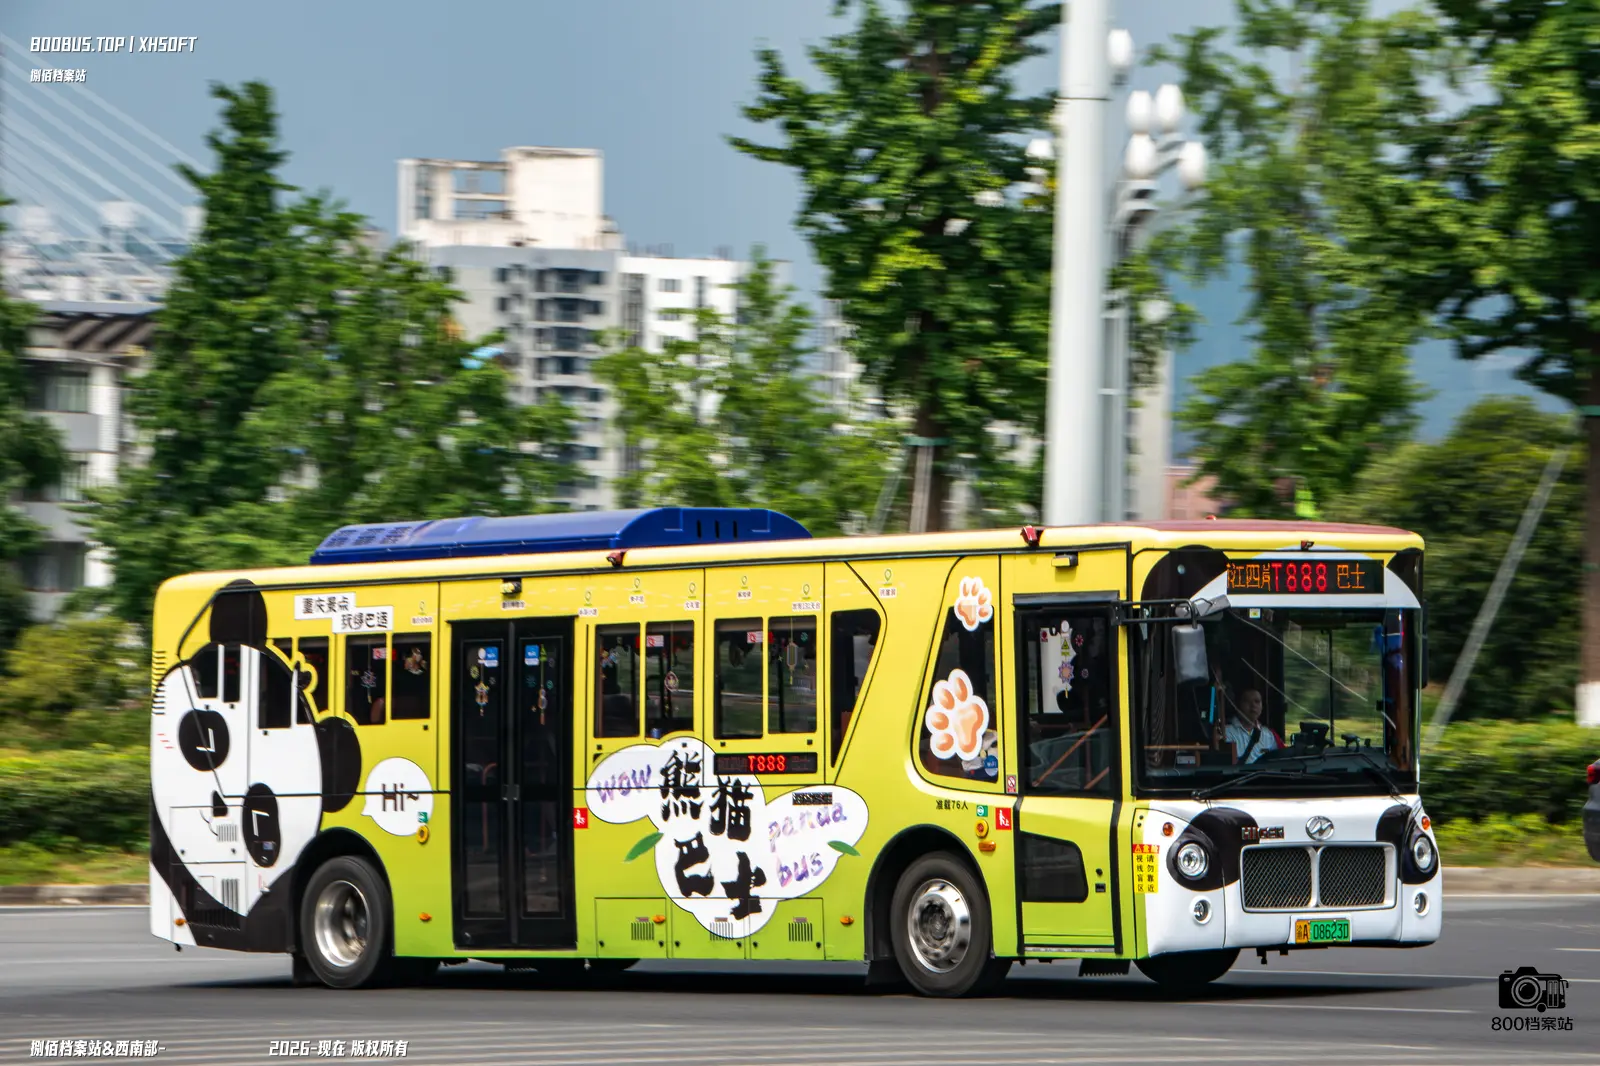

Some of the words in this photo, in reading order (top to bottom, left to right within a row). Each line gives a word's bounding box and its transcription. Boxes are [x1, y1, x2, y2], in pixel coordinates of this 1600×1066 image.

[1271, 563, 1328, 592] T888
[1337, 563, 1366, 589] 巴士
[303, 596, 349, 613] 重庆景点
[747, 754, 786, 772] T888
[659, 749, 754, 842] 熊猫
[936, 800, 969, 810] 准载76人
[767, 802, 848, 853] panda
[674, 831, 767, 921] 巴士
[778, 852, 824, 887] bus
